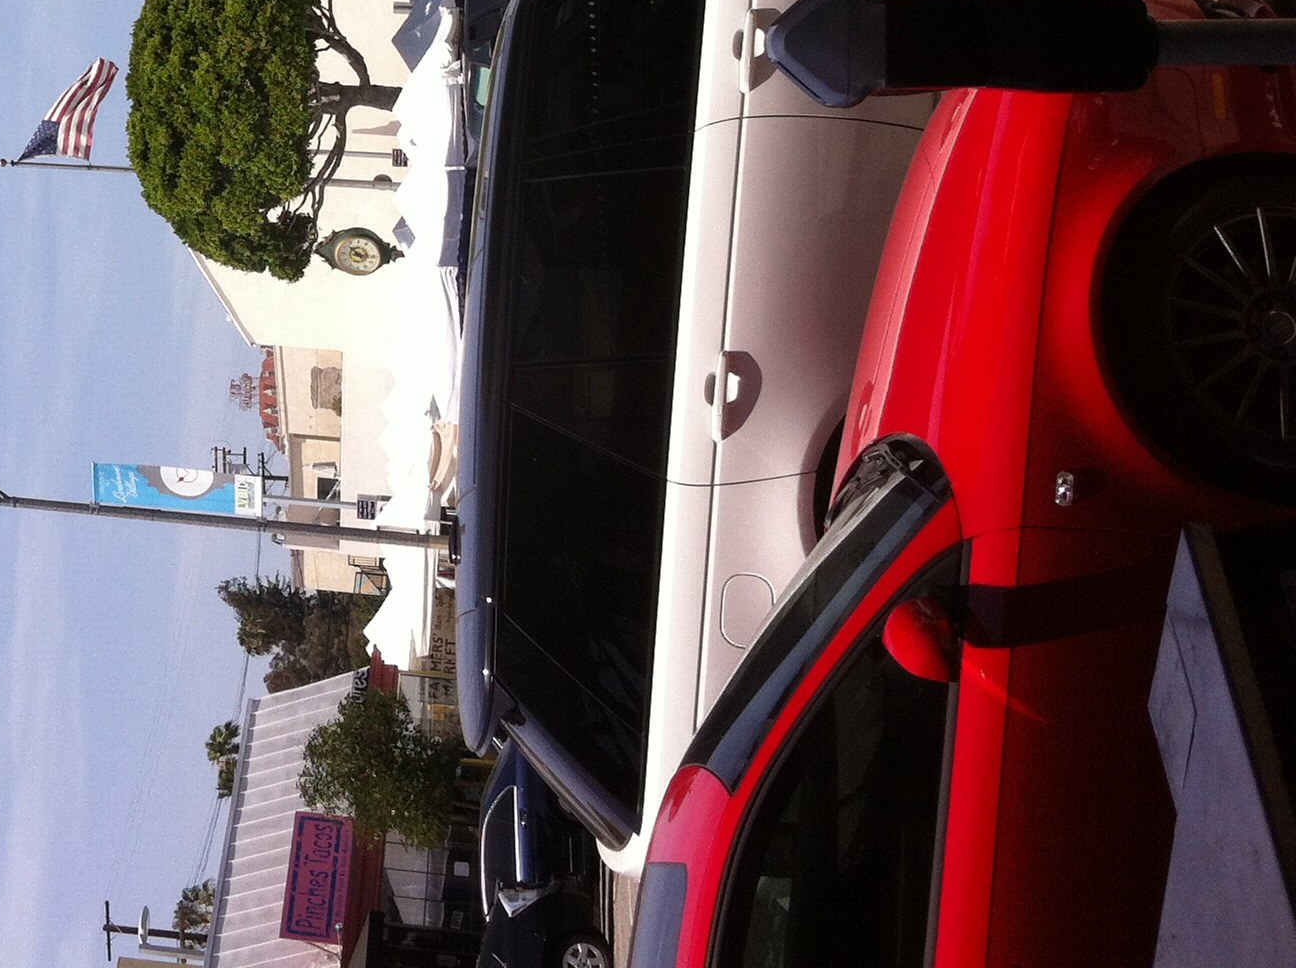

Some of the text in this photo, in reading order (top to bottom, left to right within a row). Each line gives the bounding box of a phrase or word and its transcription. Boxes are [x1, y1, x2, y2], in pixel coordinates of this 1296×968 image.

[429, 633, 443, 699] FAMERS'
[295, 823, 333, 929] Pinches Tacos
